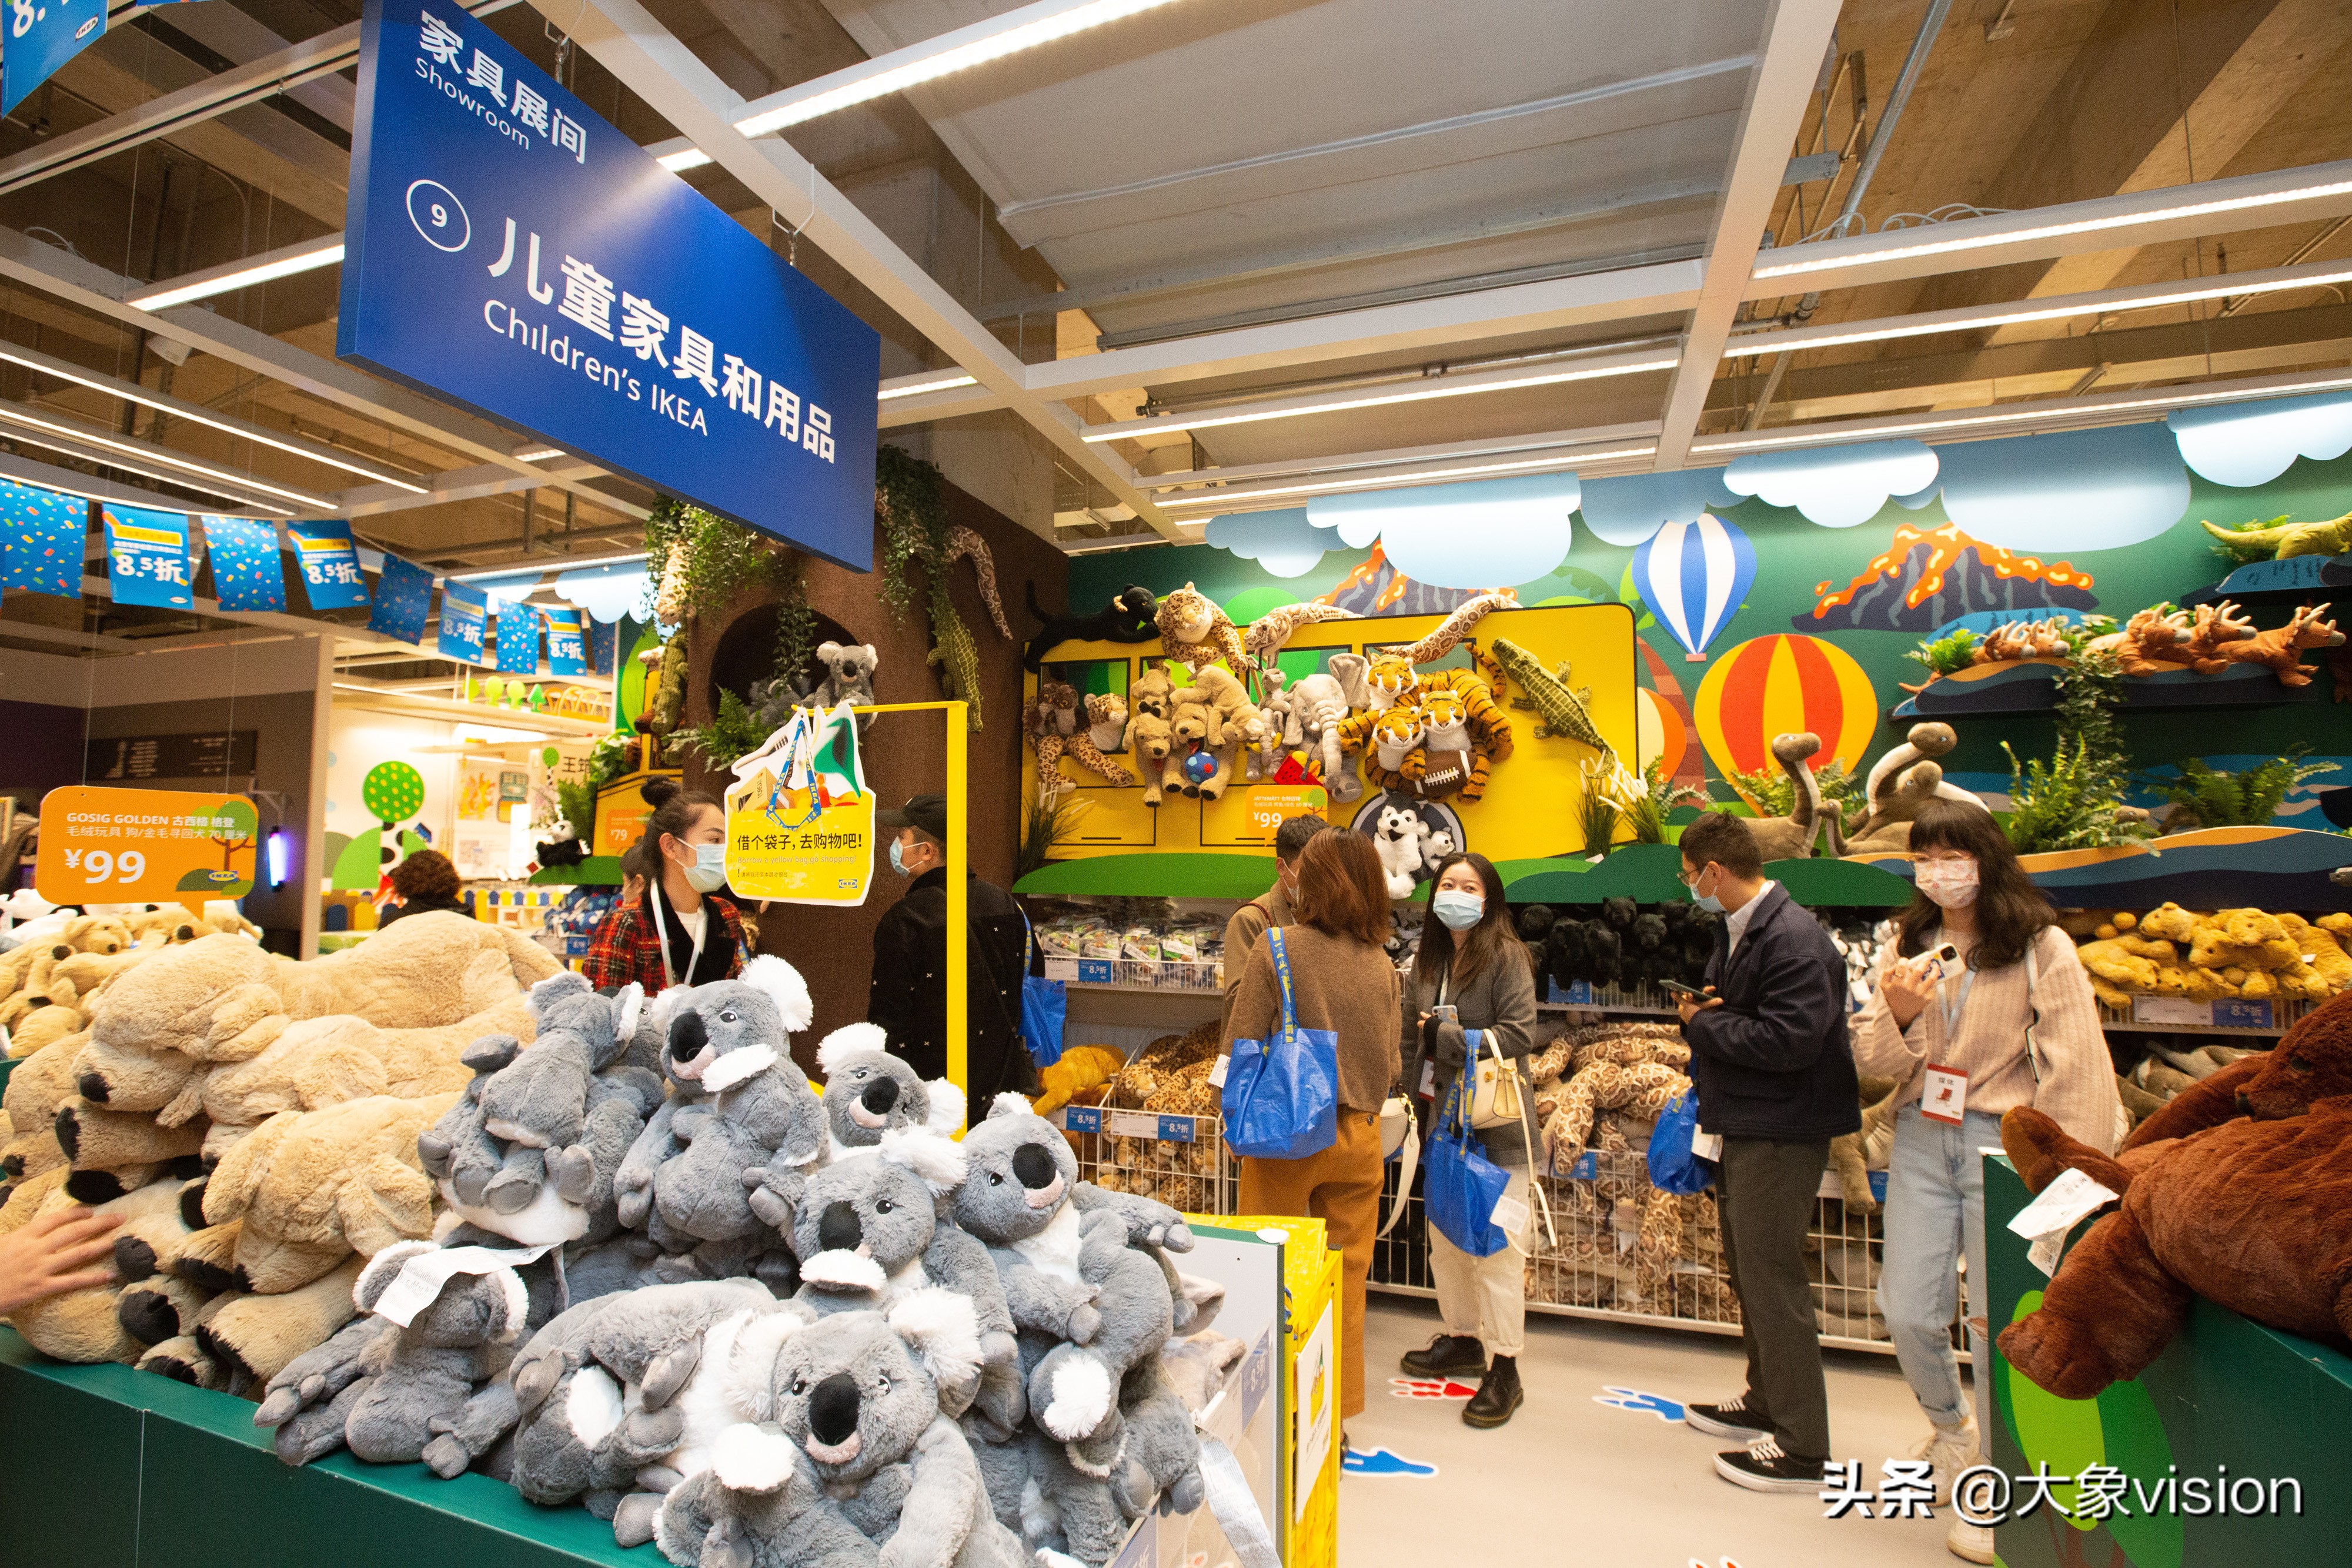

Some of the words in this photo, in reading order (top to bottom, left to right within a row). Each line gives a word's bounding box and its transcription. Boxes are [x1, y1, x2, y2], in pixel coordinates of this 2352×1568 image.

[77, 18, 98, 37] IKEA
[419, 10, 587, 165] 家具展间
[415, 56, 530, 151] Showroom
[432, 205, 447, 228] 9
[486, 217, 836, 464] 儿童家具和用品
[484, 299, 640, 400] Children’s
[652, 385, 707, 436] IKEA
[66, 813, 110, 823] GOSIG
[113, 814, 168, 825] GOLDEN
[172, 815, 208, 827] 古西格
[211, 817, 235, 828] 格登
[1254, 812, 1282, 828] ¥99
[66, 825, 121, 837] 毛绒玩具
[125, 827, 205, 839] 狗/金毛寻回犬
[208, 830, 222, 839] 70
[223, 830, 247, 840] 厘米
[737, 833, 862, 851] 借个袋子，去购物吧！
[64, 848, 146, 884] ¥99
[771, 856, 793, 864] yellow
[821, 855, 856, 864] shopping!
[1088, 965, 1107, 974] 8.5折
[1077, 1114, 1097, 1125] 8.5折
[1168, 1123, 1189, 1134] 8.5折
